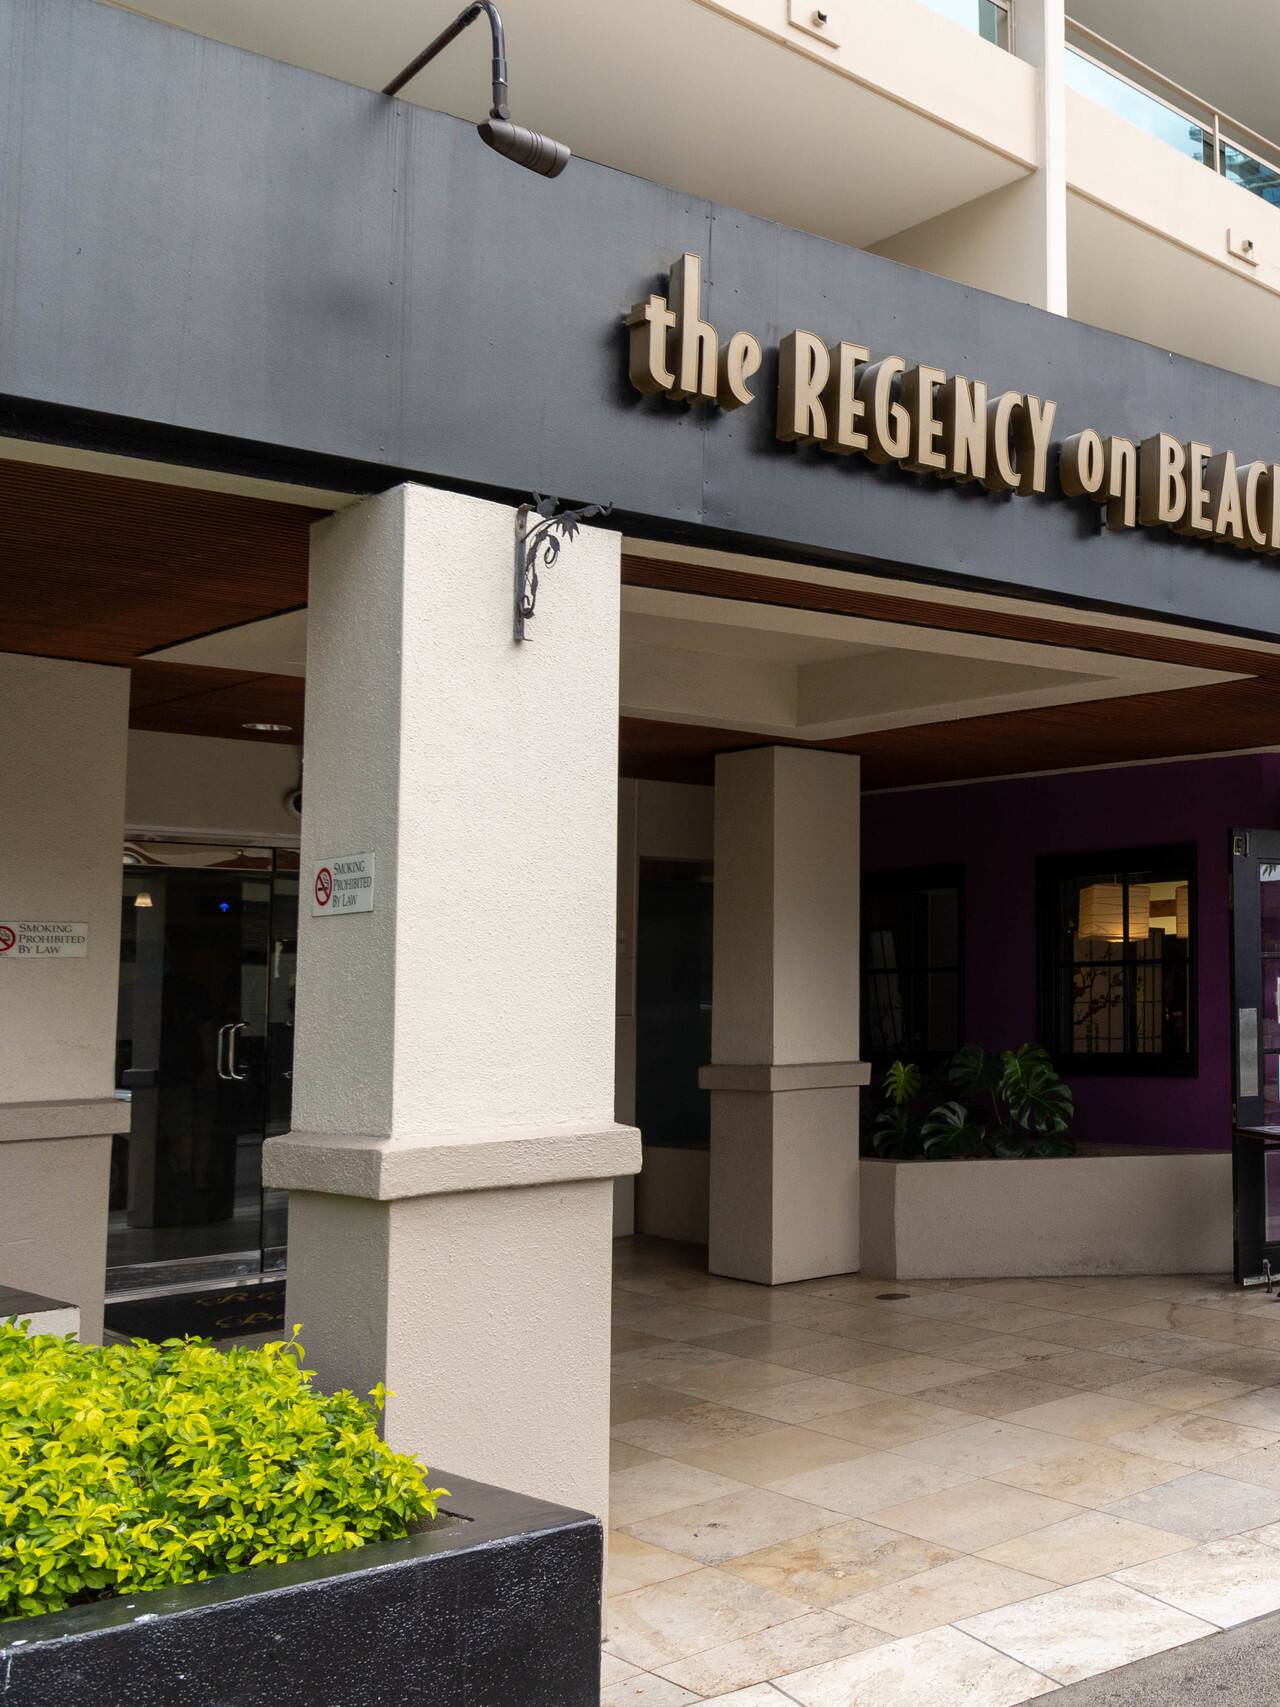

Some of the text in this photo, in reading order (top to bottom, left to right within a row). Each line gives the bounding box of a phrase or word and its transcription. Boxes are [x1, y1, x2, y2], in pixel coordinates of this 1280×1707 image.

[638, 252, 762, 407] the
[788, 328, 1057, 496] REGENCY
[1070, 428, 1137, 529] on
[333, 860, 366, 876] SMOKING
[332, 876, 372, 891] PROHIBITED
[18, 923, 73, 934] SMOKING
[18, 934, 86, 944] PROHIBITED
